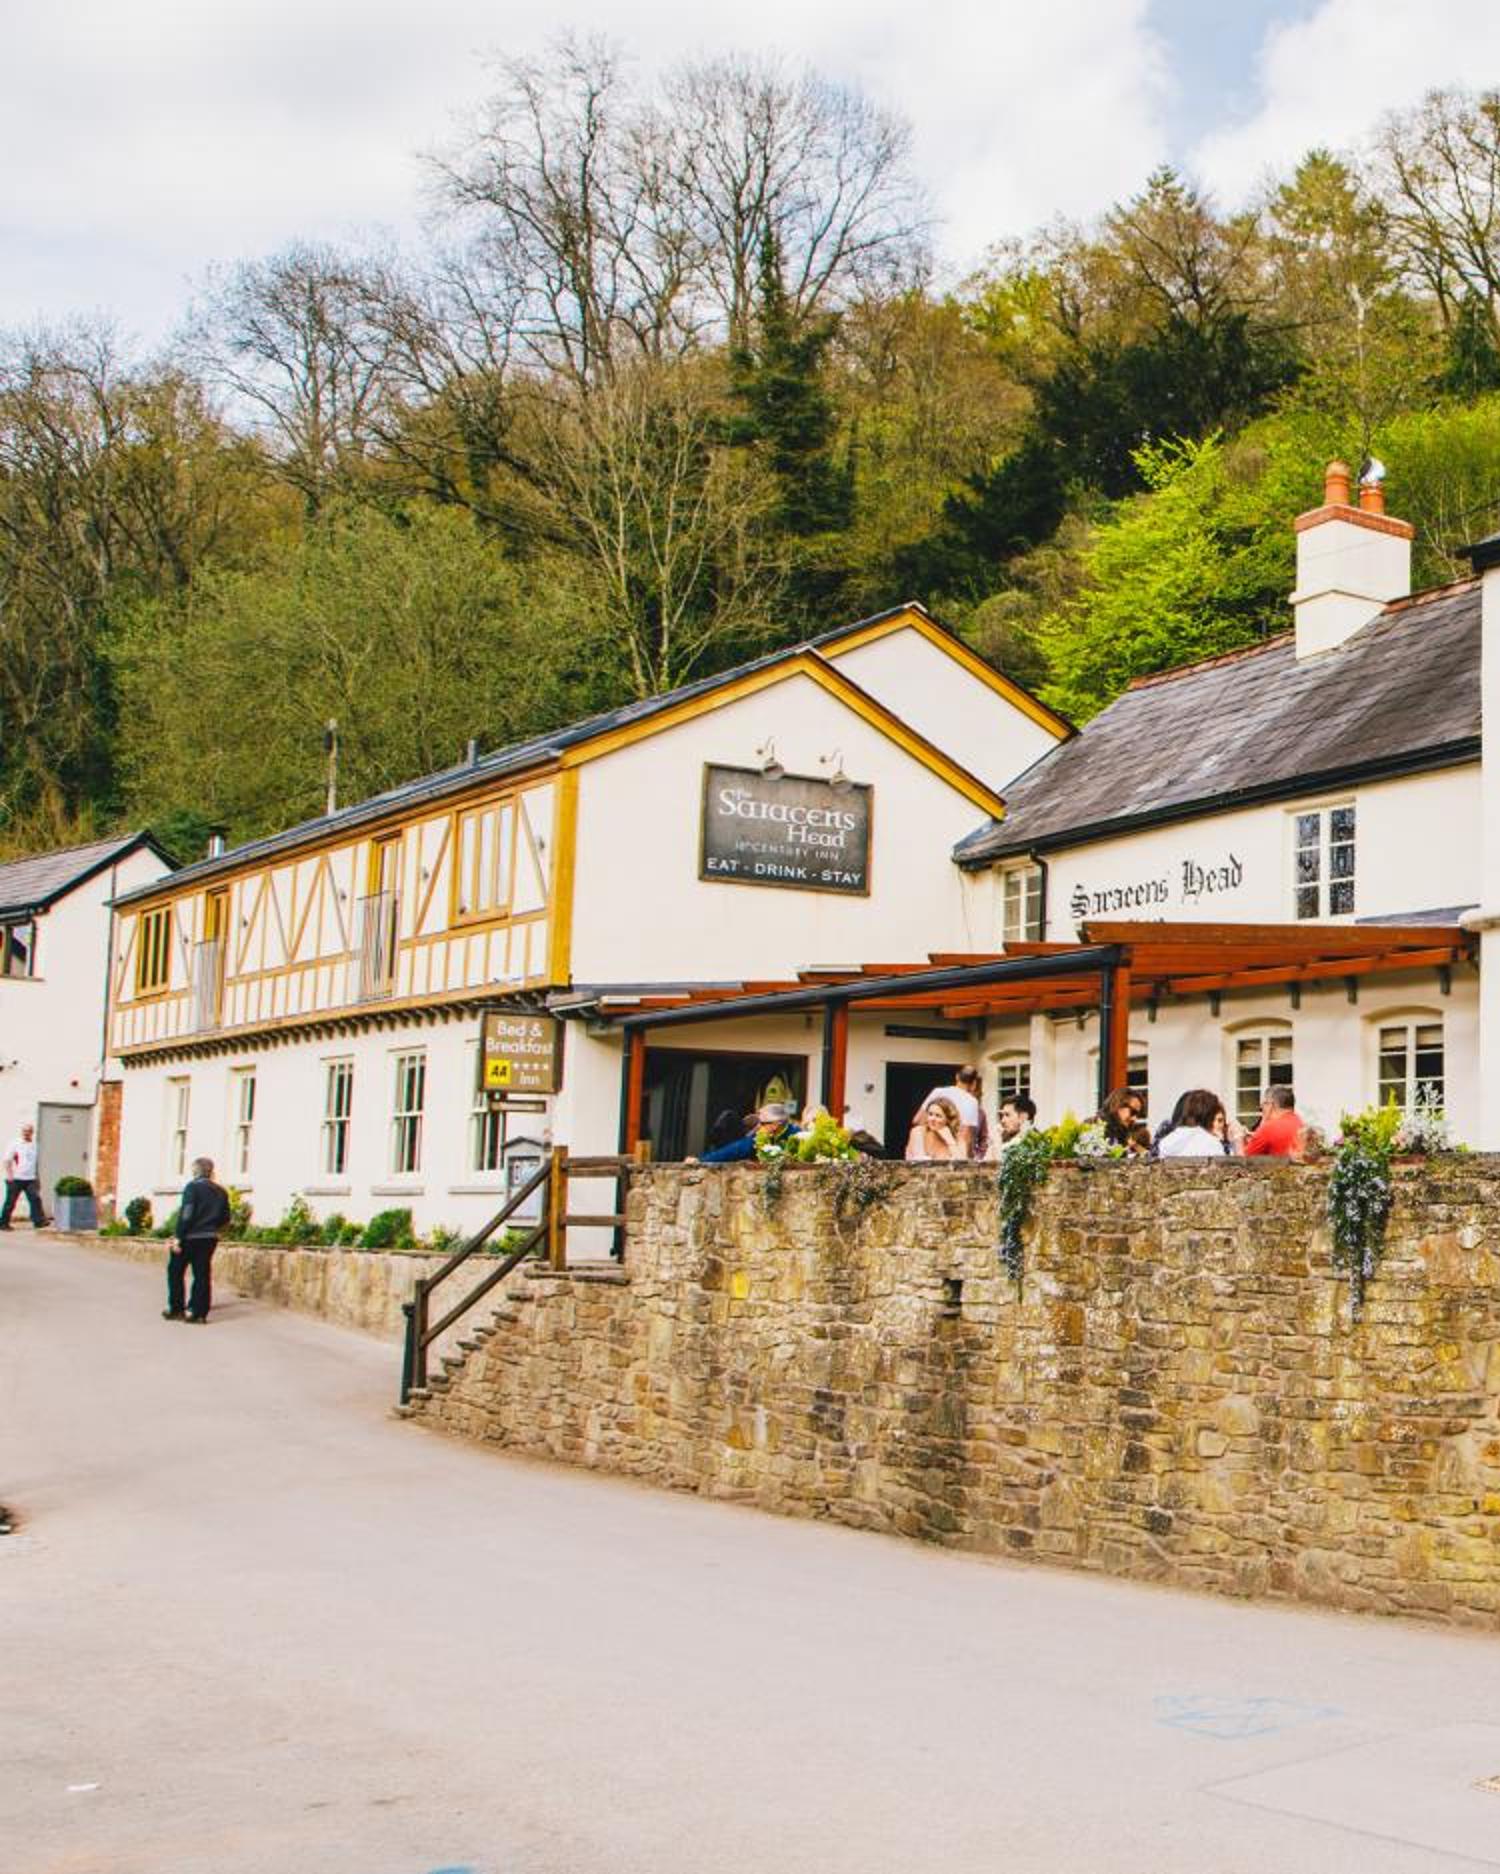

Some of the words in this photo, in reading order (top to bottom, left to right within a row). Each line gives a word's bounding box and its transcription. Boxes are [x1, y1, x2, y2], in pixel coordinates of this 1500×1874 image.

[719, 789, 856, 831] Saracens
[787, 823, 846, 849] Head
[815, 849, 839, 861] INN
[707, 857, 739, 872] EAT
[755, 863, 808, 880] DRINK
[821, 869, 862, 885] STAY
[1181, 853, 1243, 905] Head
[497, 1020, 526, 1037] Bed
[529, 1022, 543, 1037] &
[486, 1037, 553, 1055] Breakfast
[490, 1064, 508, 1077] AA
